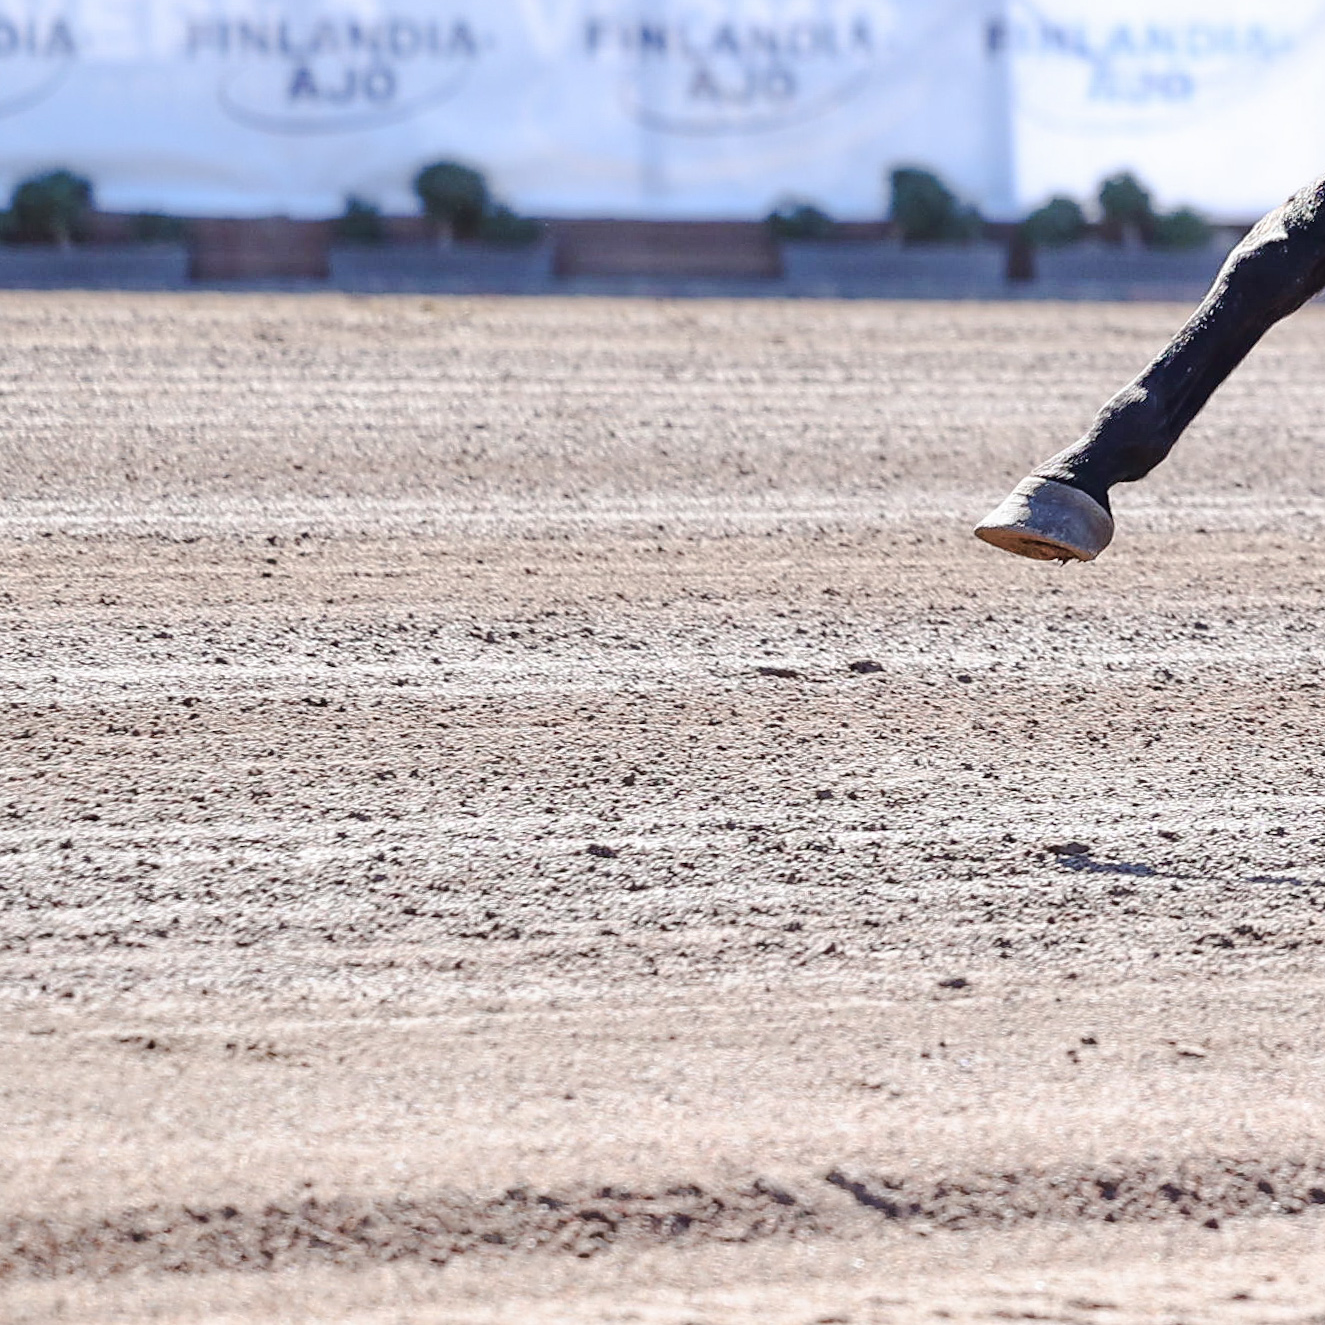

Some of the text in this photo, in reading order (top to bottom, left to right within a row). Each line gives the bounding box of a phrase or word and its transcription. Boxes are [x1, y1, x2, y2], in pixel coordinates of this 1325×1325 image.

[185, 14, 478, 58] FINLANDIA
[582, 14, 873, 58] FINLANDIA
[287, 65, 398, 104] AJO
[688, 65, 801, 104] AJO
